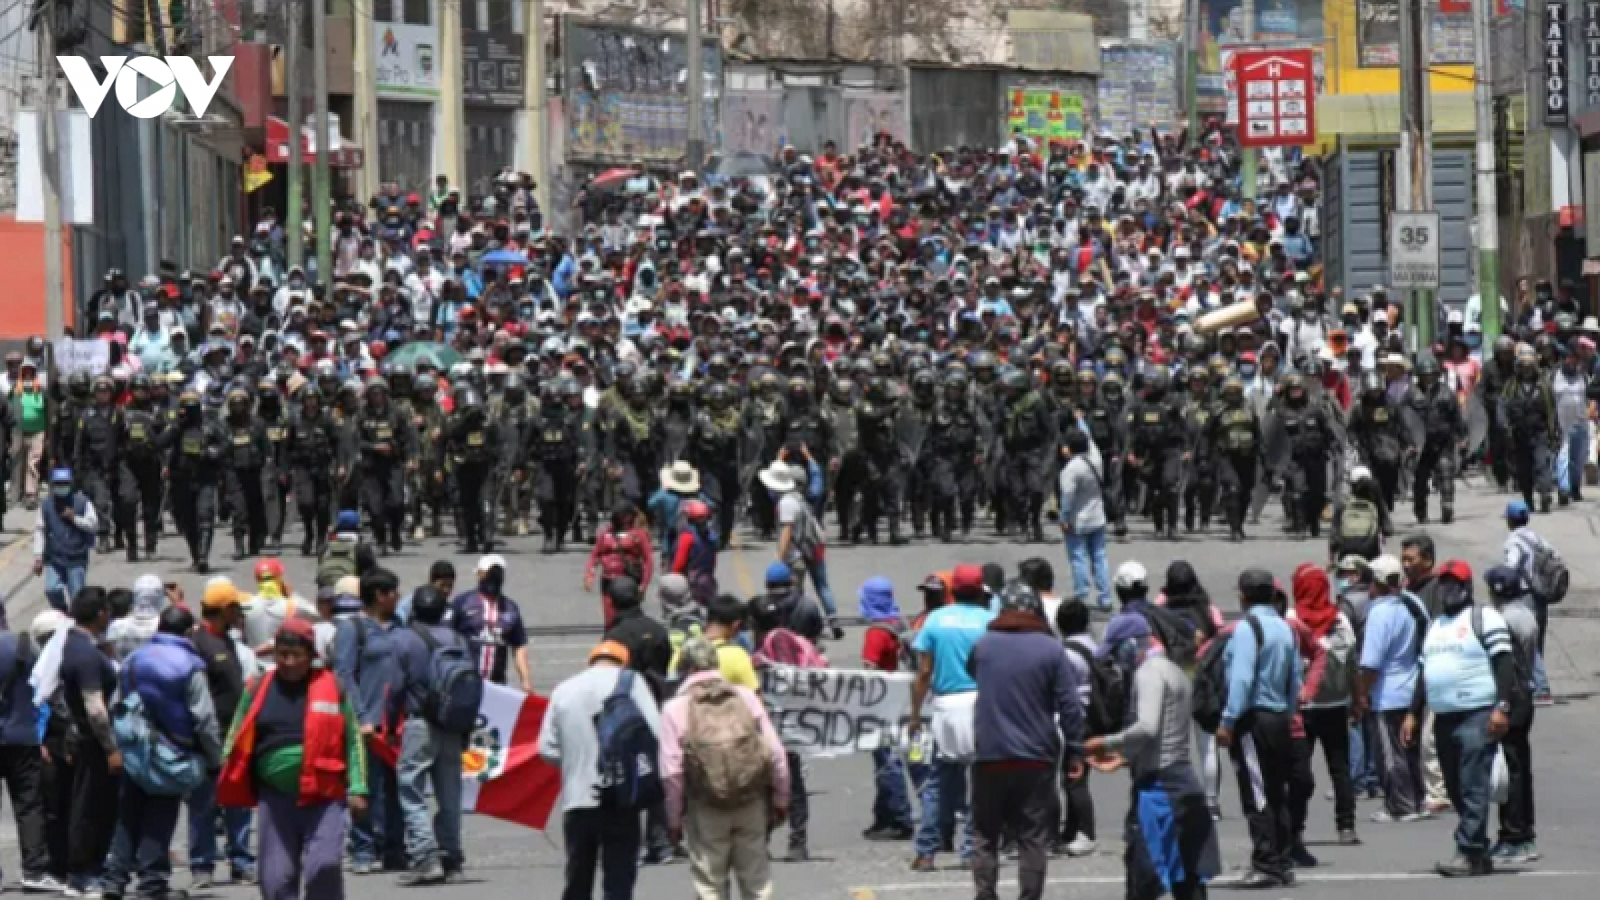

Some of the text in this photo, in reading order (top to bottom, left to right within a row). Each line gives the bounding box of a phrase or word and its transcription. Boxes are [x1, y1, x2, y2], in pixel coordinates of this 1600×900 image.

[1547, 4, 1562, 109] TATTOO
[1267, 63, 1281, 77] H
[1400, 226, 1428, 245] 35
